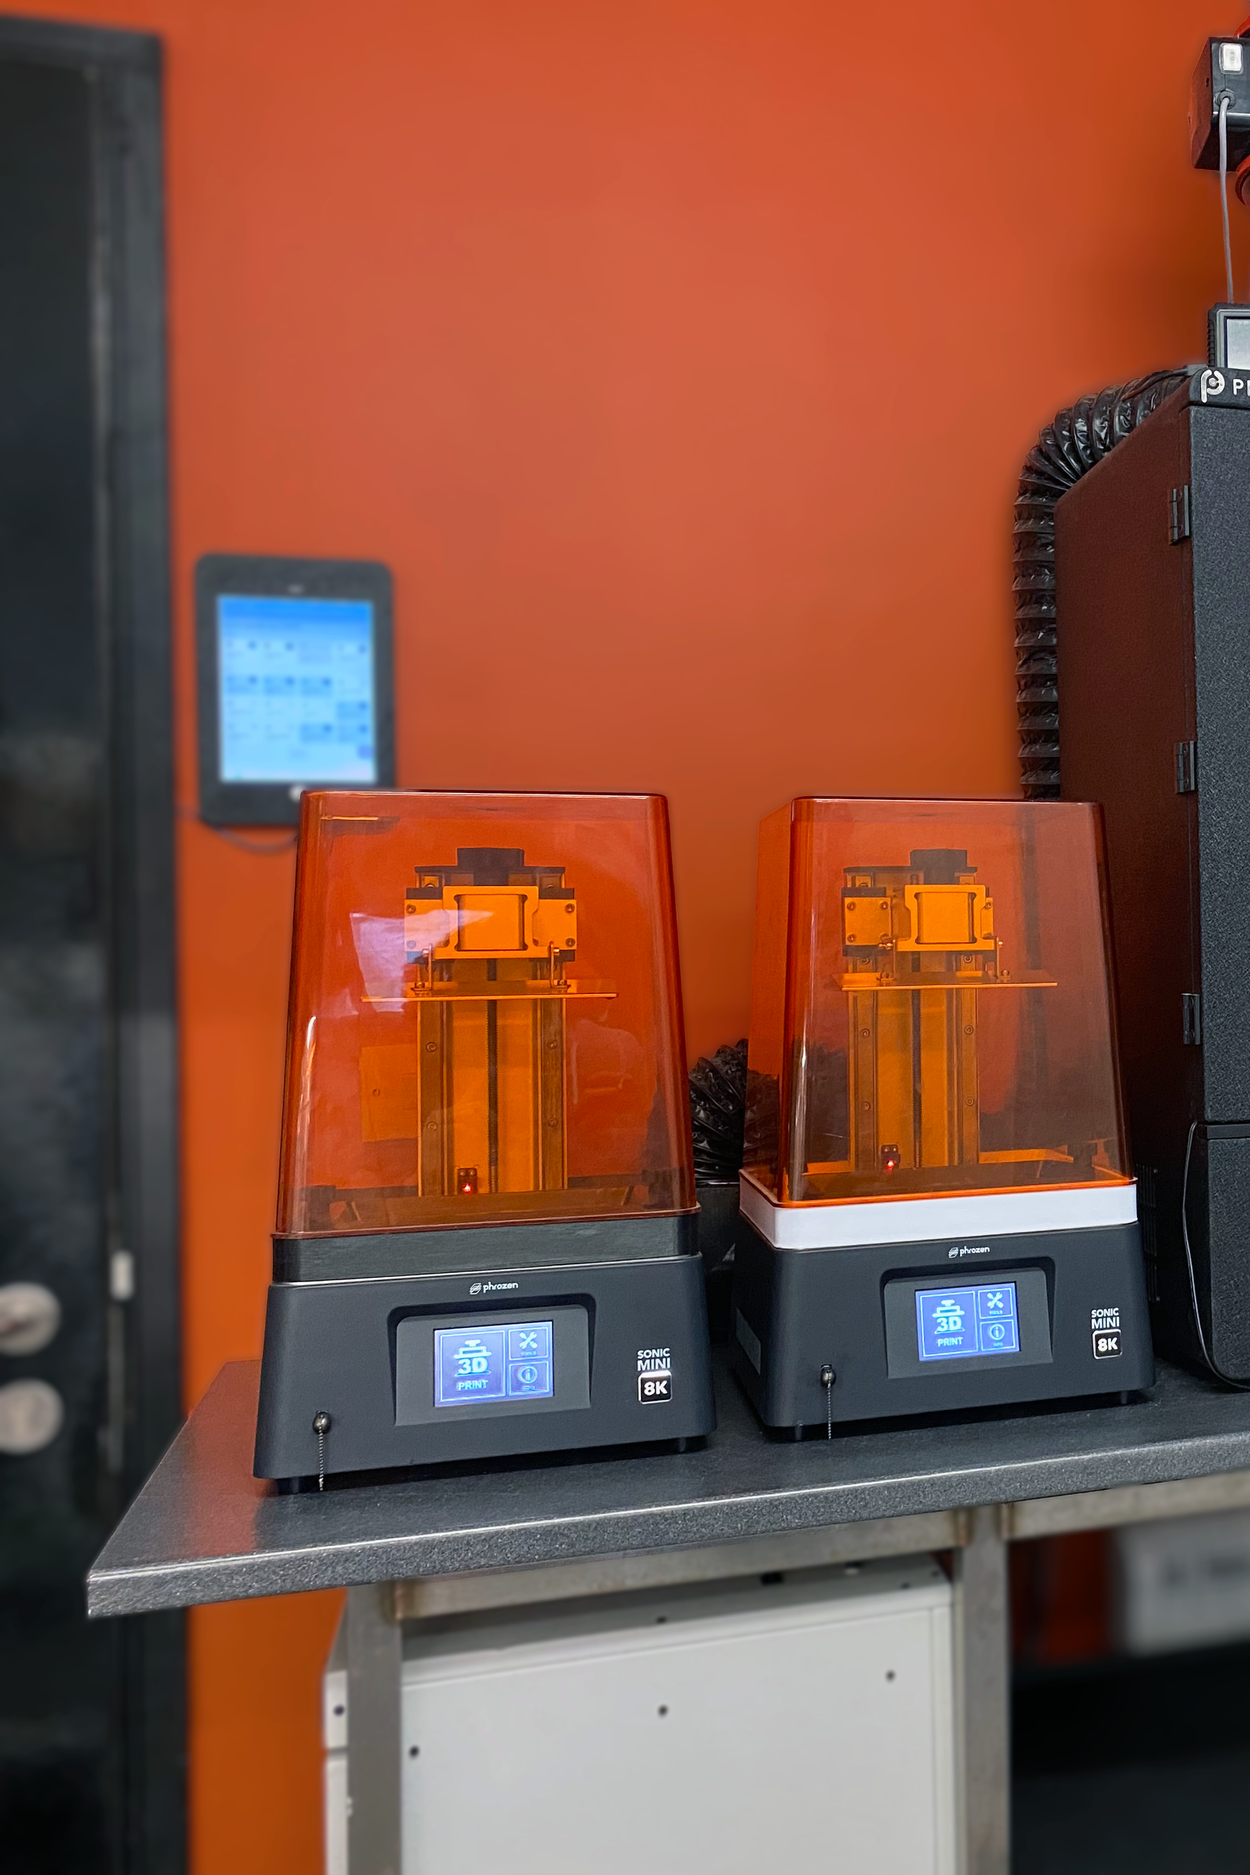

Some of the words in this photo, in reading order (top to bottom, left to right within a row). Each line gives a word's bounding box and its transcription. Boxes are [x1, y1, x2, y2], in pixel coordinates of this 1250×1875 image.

[960, 1245, 990, 1257] phrozen
[483, 1281, 519, 1293] phrozen
[1091, 1307, 1119, 1318] SONIC
[936, 1316, 962, 1332] 3D
[1091, 1316, 1120, 1329] MINI
[937, 1336, 963, 1347] PRINT
[1097, 1337, 1118, 1351] 8K
[637, 1347, 670, 1359] SONIC
[458, 1357, 488, 1374] 3D
[637, 1358, 671, 1371] MINI
[458, 1380, 488, 1391] PRINT
[644, 1380, 668, 1396] 8K
